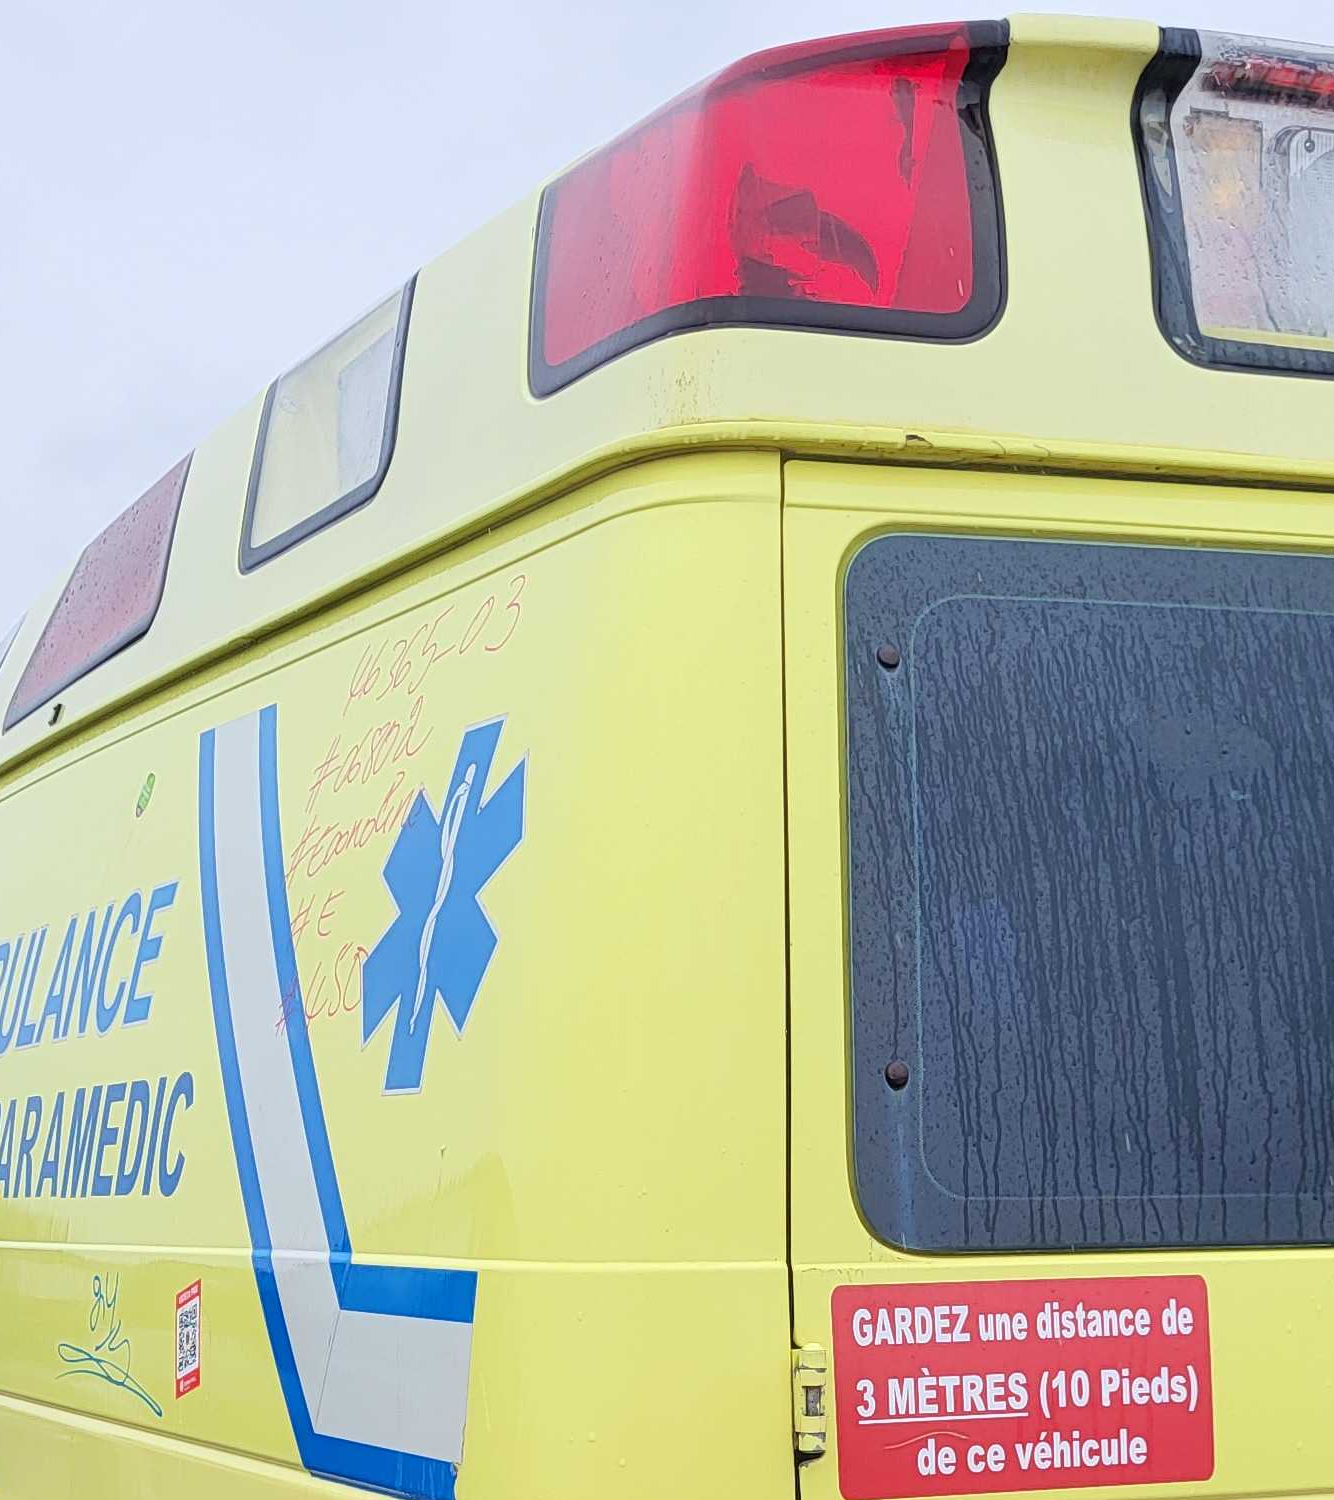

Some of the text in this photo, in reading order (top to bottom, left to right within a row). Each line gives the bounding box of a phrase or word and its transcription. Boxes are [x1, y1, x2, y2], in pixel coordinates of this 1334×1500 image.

[852, 1299, 1194, 1347] GARDEZ une distance de
[856, 1366, 1198, 1418] 3 MÈTRES (10 Pieds)
[917, 1429, 1147, 1477] de ce véhicule
